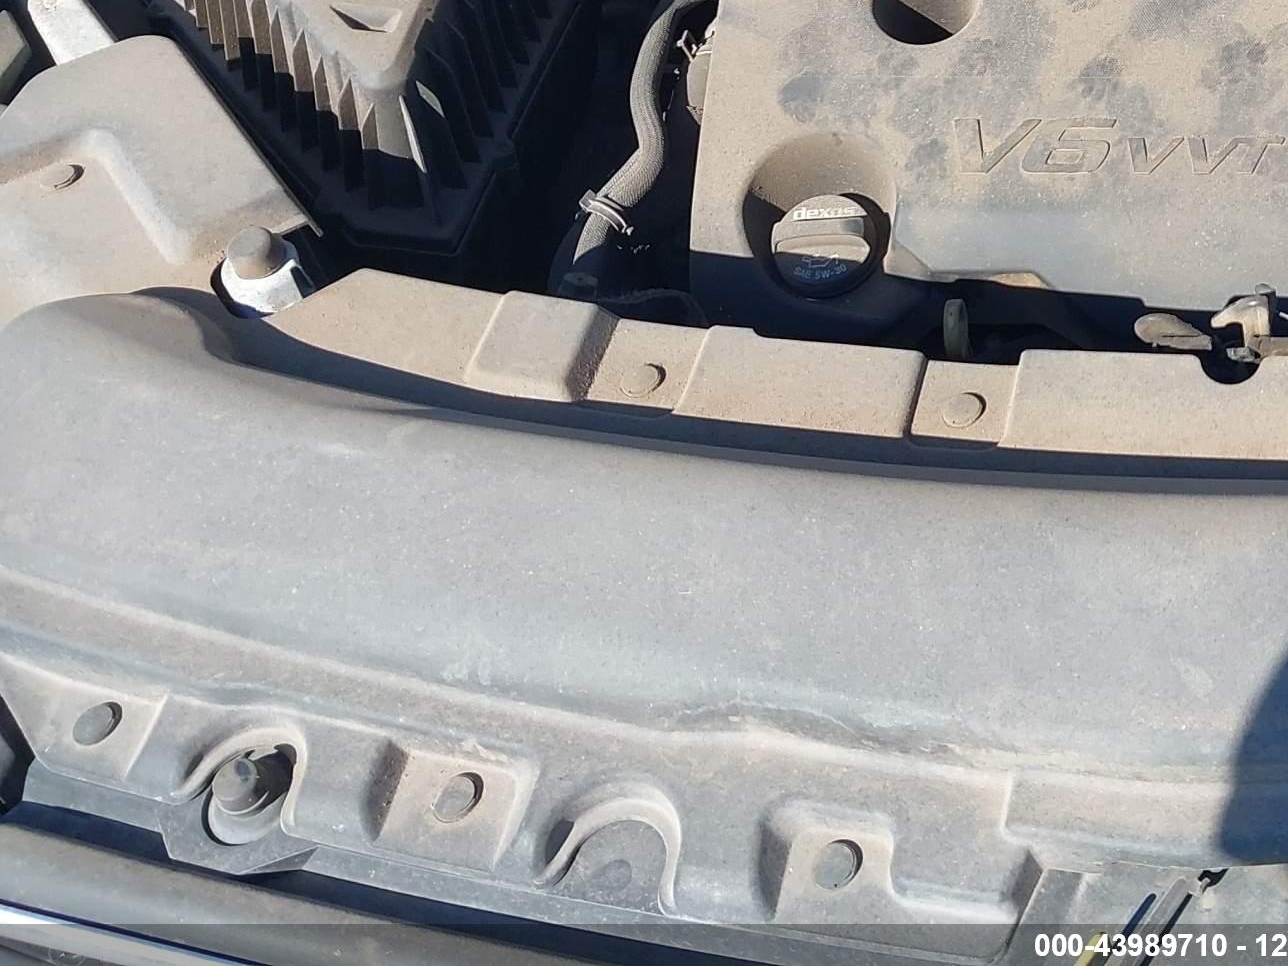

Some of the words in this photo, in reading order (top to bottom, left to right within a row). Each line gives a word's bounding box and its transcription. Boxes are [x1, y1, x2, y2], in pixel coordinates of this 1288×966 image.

[954, 118, 1118, 174] V6
[1127, 136, 1287, 175] VVT
[793, 206, 858, 221] dexos
[793, 266, 812, 279] SAE
[814, 264, 847, 280] 5W-30
